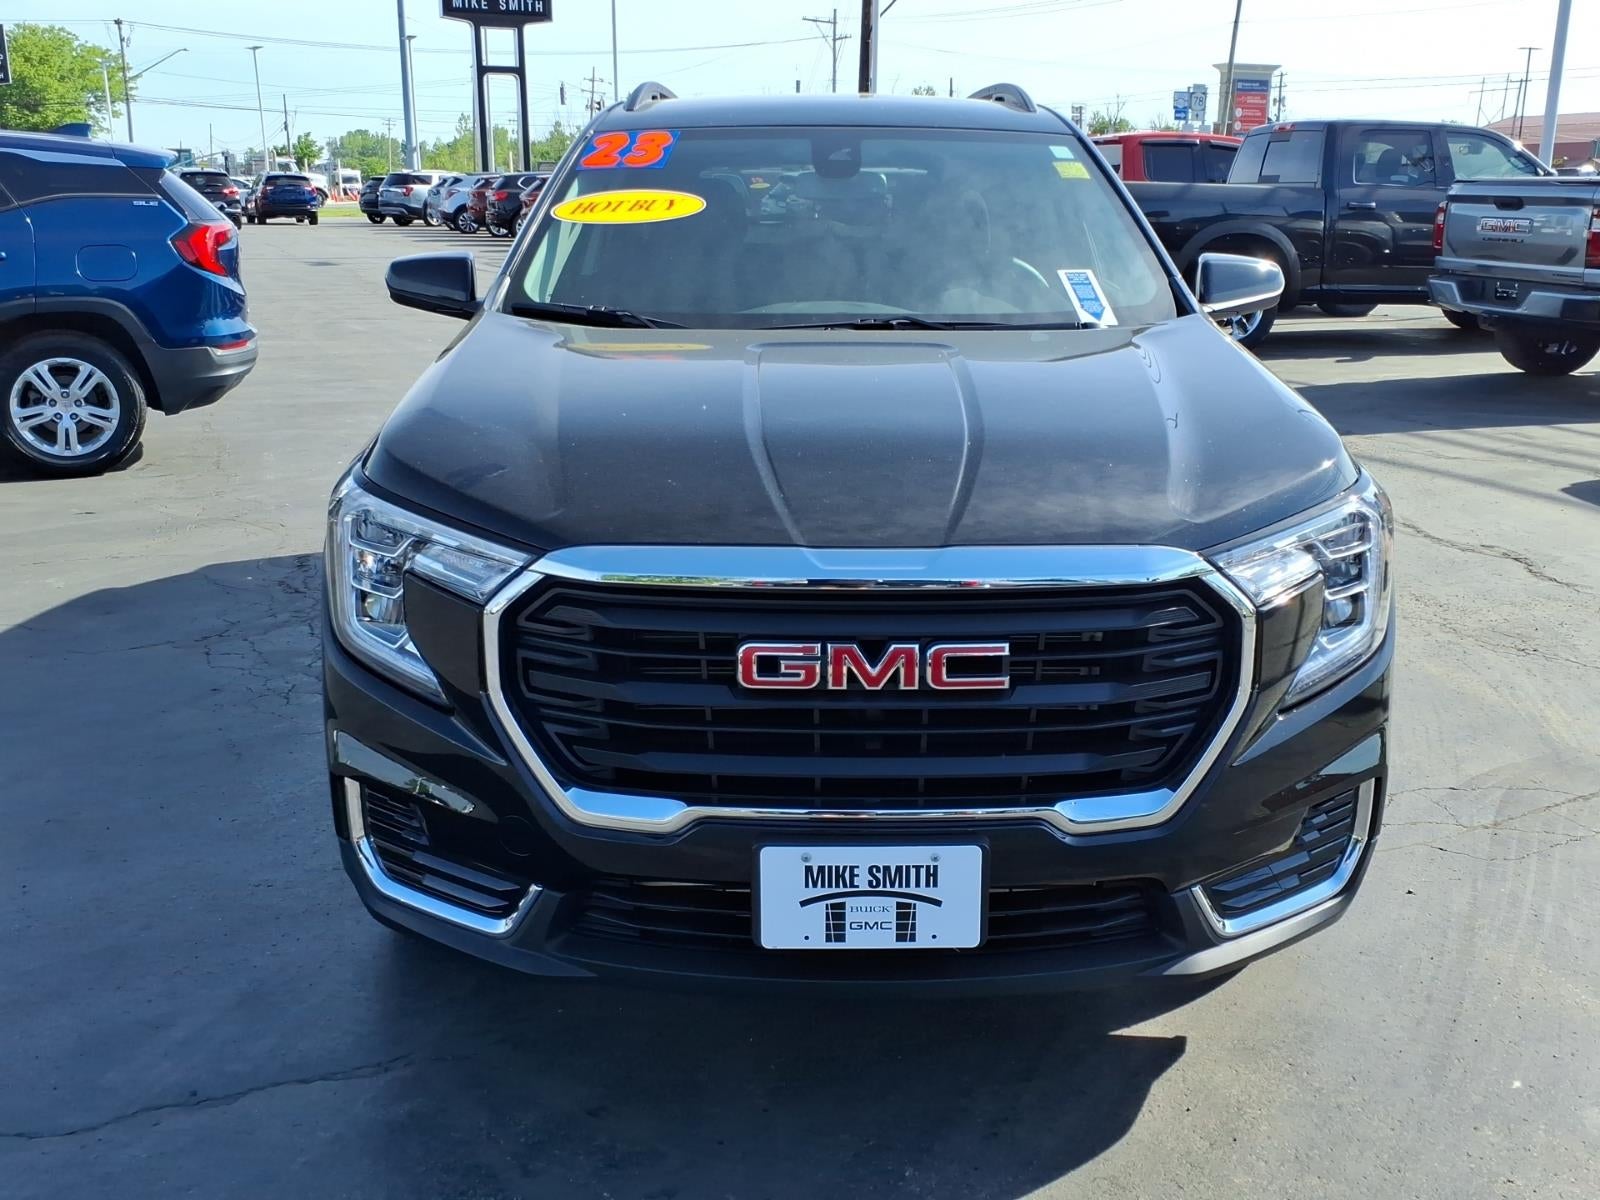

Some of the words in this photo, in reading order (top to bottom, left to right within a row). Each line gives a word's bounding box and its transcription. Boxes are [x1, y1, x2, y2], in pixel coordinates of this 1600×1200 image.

[452, 0, 488, 9] MIKE
[499, 0, 543, 12] SMITH
[1193, 96, 1204, 107] 78
[581, 131, 673, 168] 23
[569, 200, 630, 215] HOT
[628, 199, 685, 212] BUY
[1480, 217, 1531, 234] GMC
[737, 642, 1010, 691] GMC
[804, 865, 860, 888] MIKE
[867, 864, 939, 889] SMITH
[849, 905, 892, 913] BUICK
[849, 921, 893, 930] GMC
